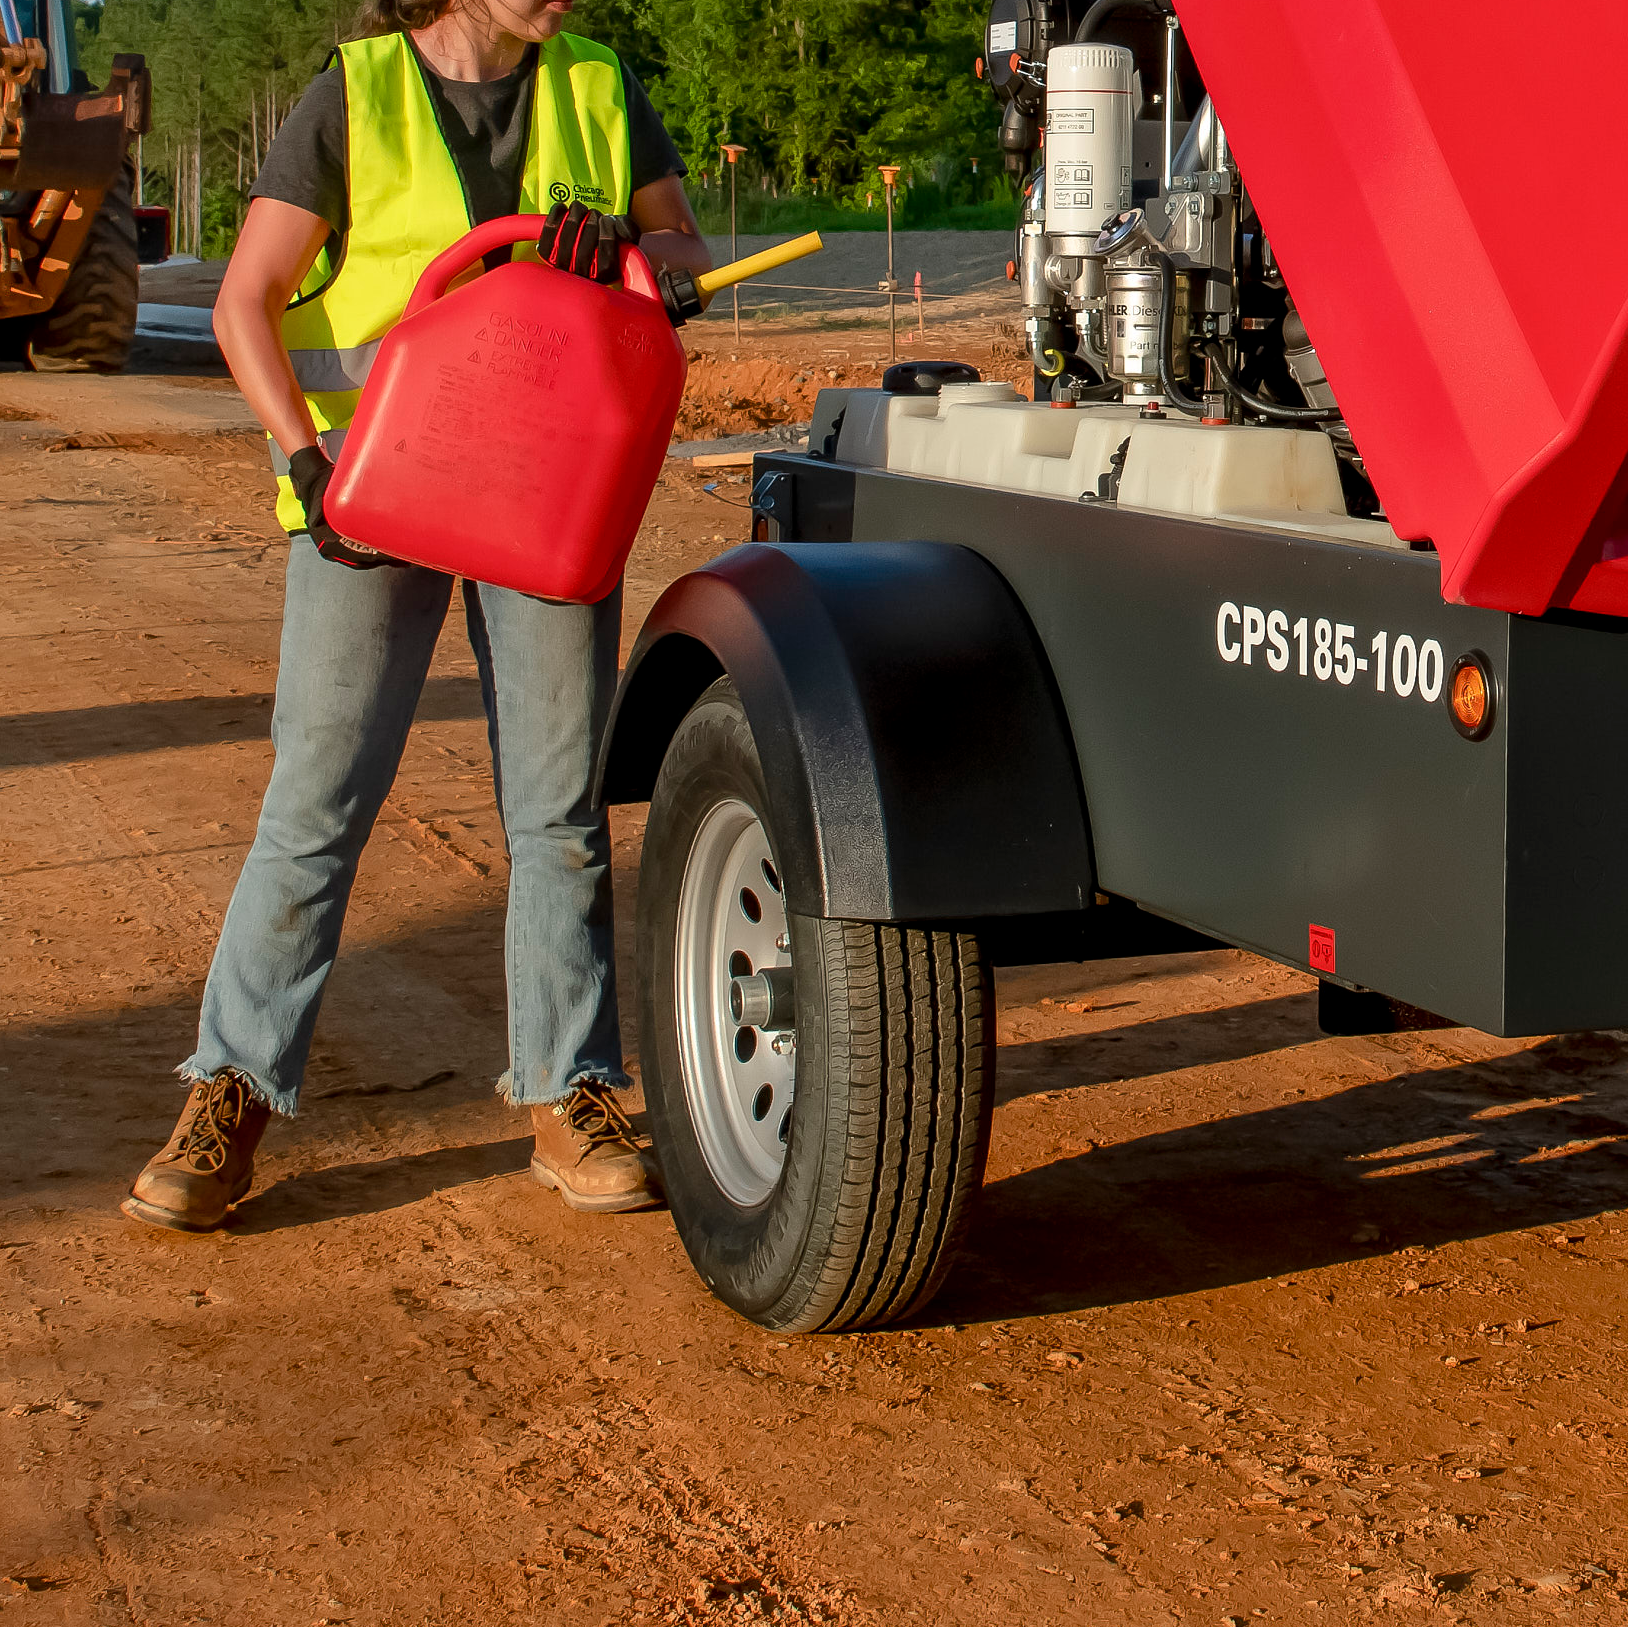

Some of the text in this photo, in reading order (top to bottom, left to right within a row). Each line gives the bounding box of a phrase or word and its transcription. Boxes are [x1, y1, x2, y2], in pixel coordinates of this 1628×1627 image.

[573, 184, 605, 197] Chicago
[1132, 305, 1161, 316] Dies
[493, 330, 563, 363] DANGER
[1130, 341, 1150, 350] Part
[1216, 601, 1444, 703] CPS185-100
